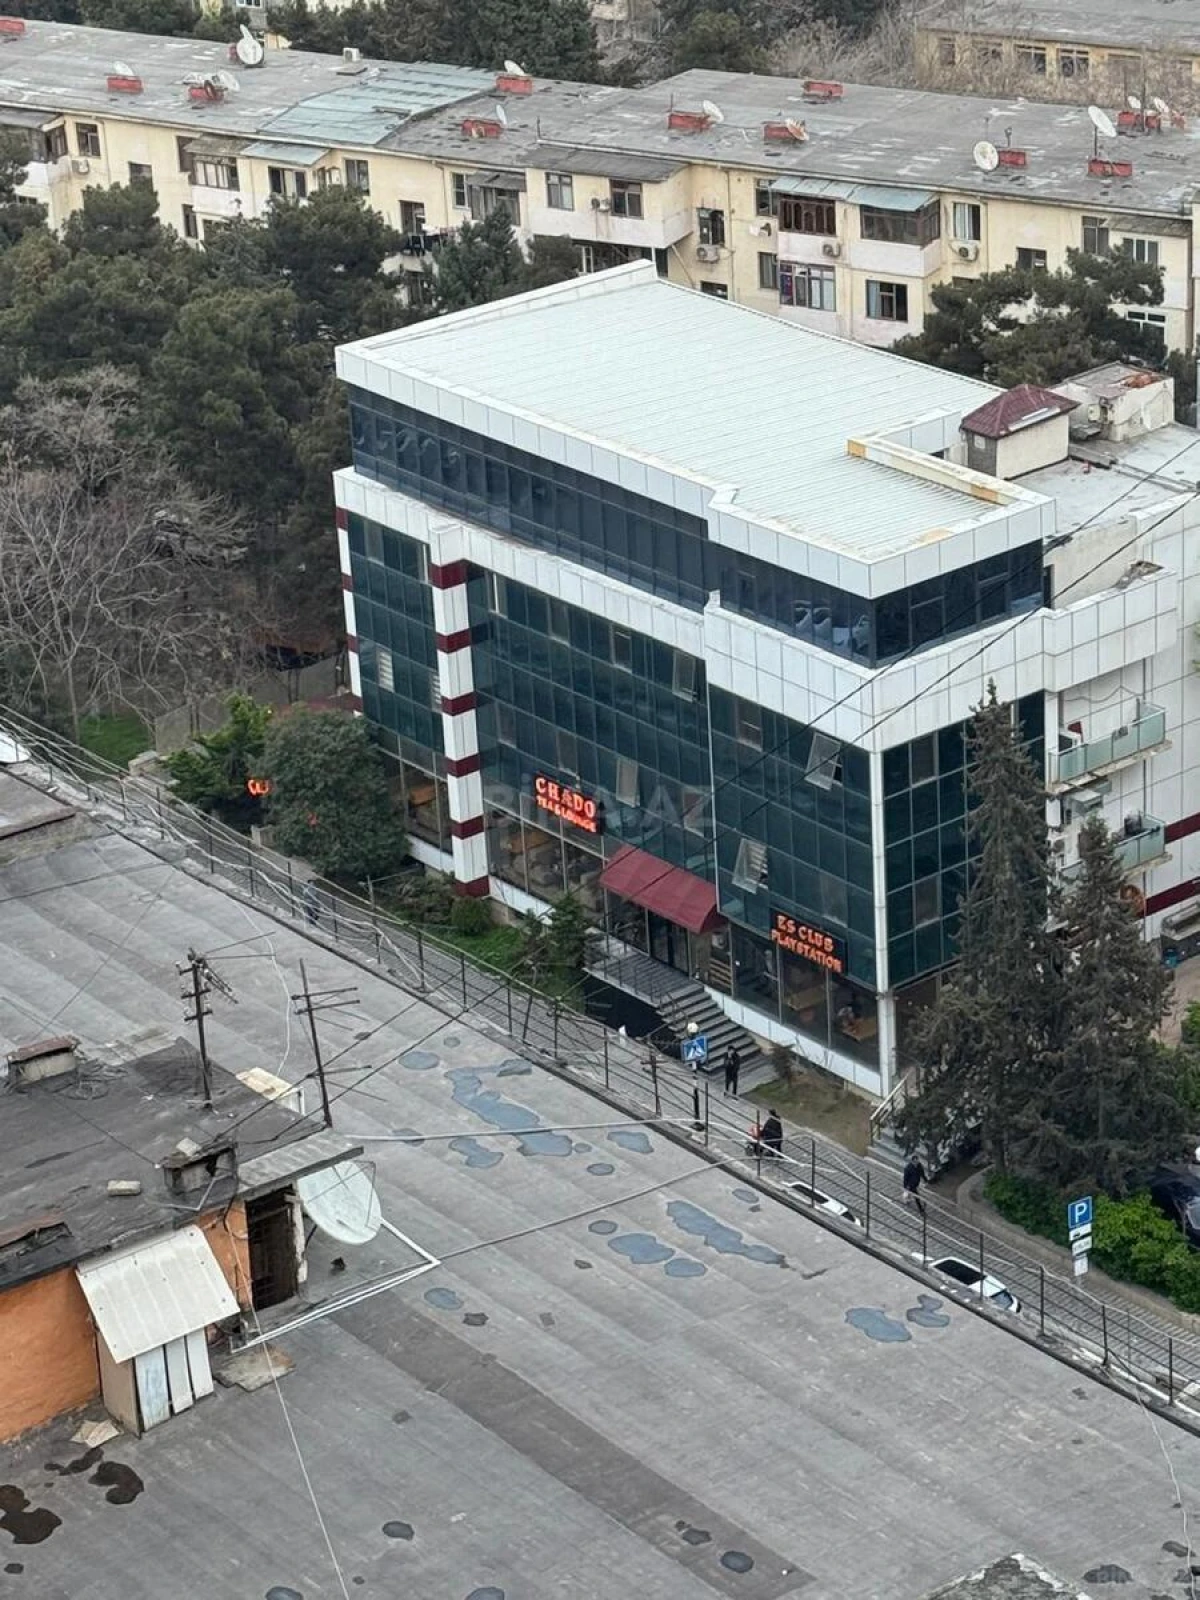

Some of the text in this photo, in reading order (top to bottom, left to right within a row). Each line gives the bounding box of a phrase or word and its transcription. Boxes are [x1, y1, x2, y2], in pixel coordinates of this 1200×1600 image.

[535, 777, 597, 819] CHADO
[798, 926, 834, 953] CLUB
[1075, 1202, 1088, 1223] P
